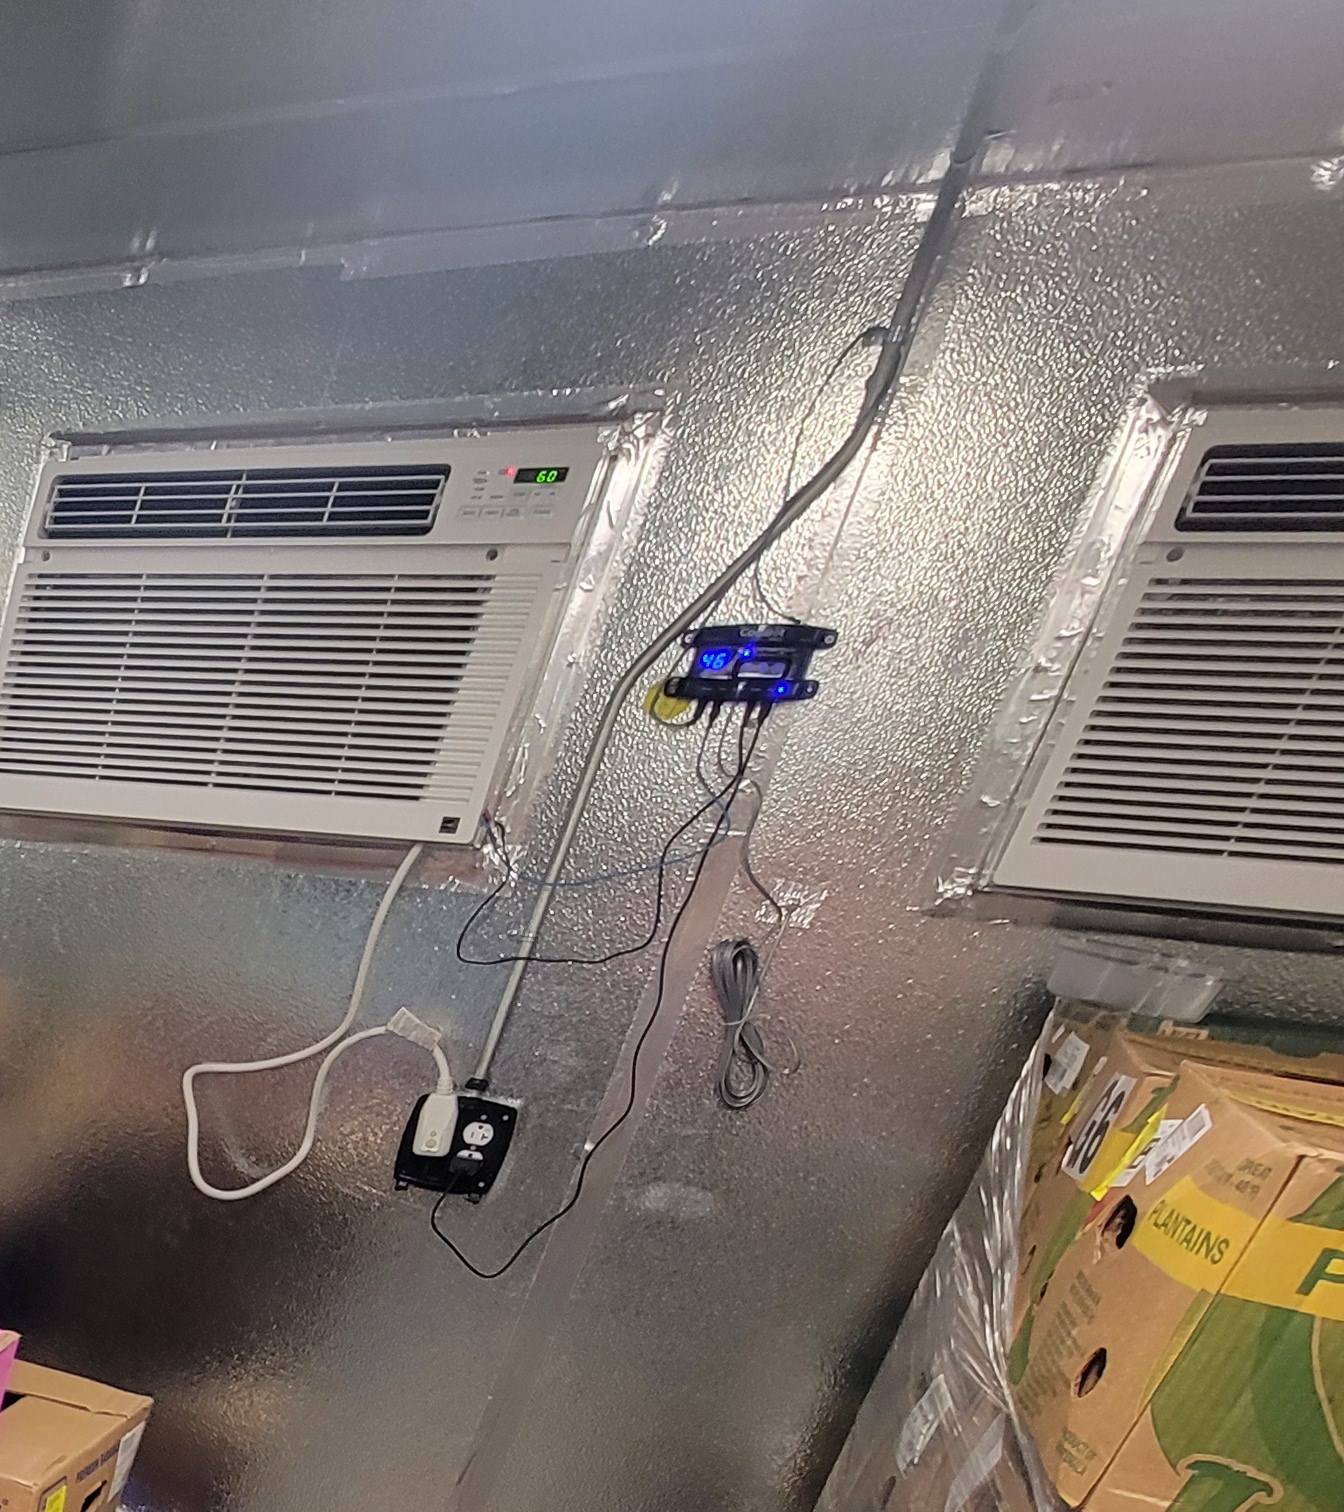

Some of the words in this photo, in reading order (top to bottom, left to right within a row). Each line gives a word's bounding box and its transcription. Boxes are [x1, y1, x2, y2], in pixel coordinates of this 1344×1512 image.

[536, 470, 558, 483] 60
[702, 652, 727, 669] 46
[1147, 1199, 1231, 1265] PLANTAINS
